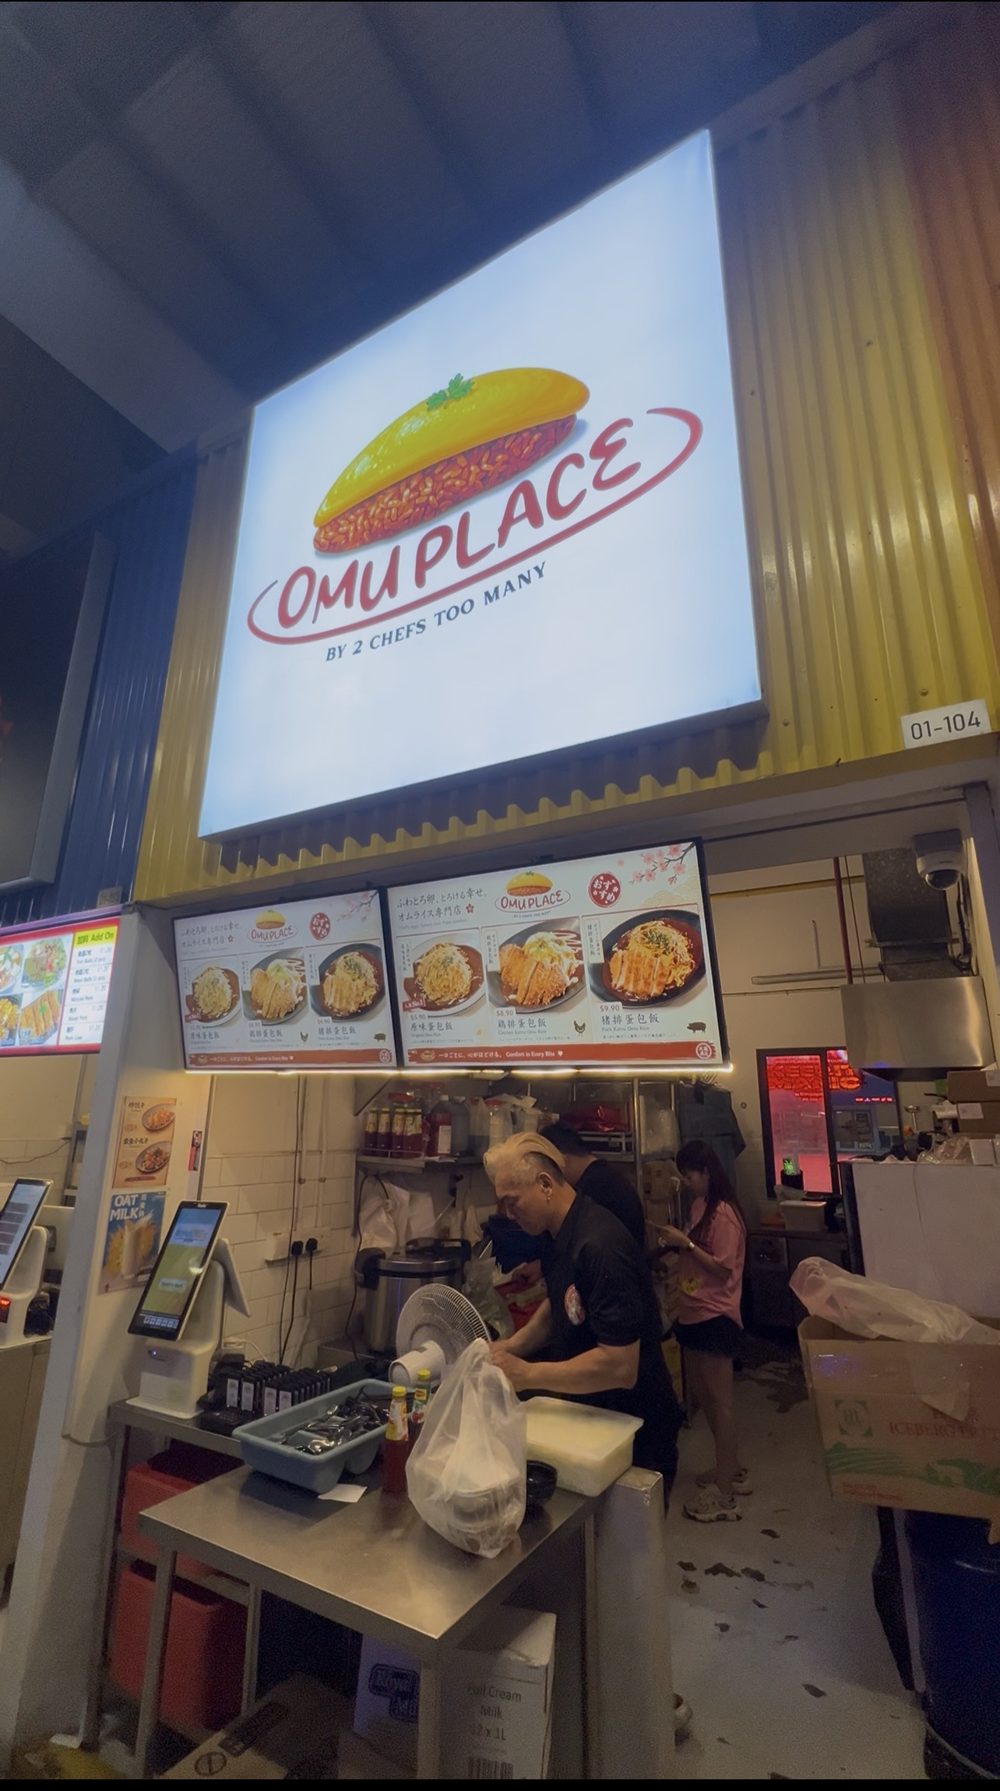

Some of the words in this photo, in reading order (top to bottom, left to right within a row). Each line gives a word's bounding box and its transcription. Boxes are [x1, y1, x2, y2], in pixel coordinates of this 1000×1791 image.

[277, 544, 401, 629] OMU
[413, 417, 642, 589] PLACE
[325, 643, 348, 662] BY
[352, 640, 363, 656] 2
[369, 618, 427, 650] CHEFS
[434, 599, 475, 627] TOO
[483, 561, 548, 607] MANY
[910, 710, 981, 741] 01-104
[500, 895, 527, 910] OMU
[528, 889, 564, 909] PLACE
[91, 933, 104, 942] Add
[104, 931, 115, 940] On
[114, 1194, 139, 1208] OAT
[109, 1207, 139, 1222] MILK
[488, 1685, 522, 1703] Cream
[480, 1704, 502, 1719] Milk
